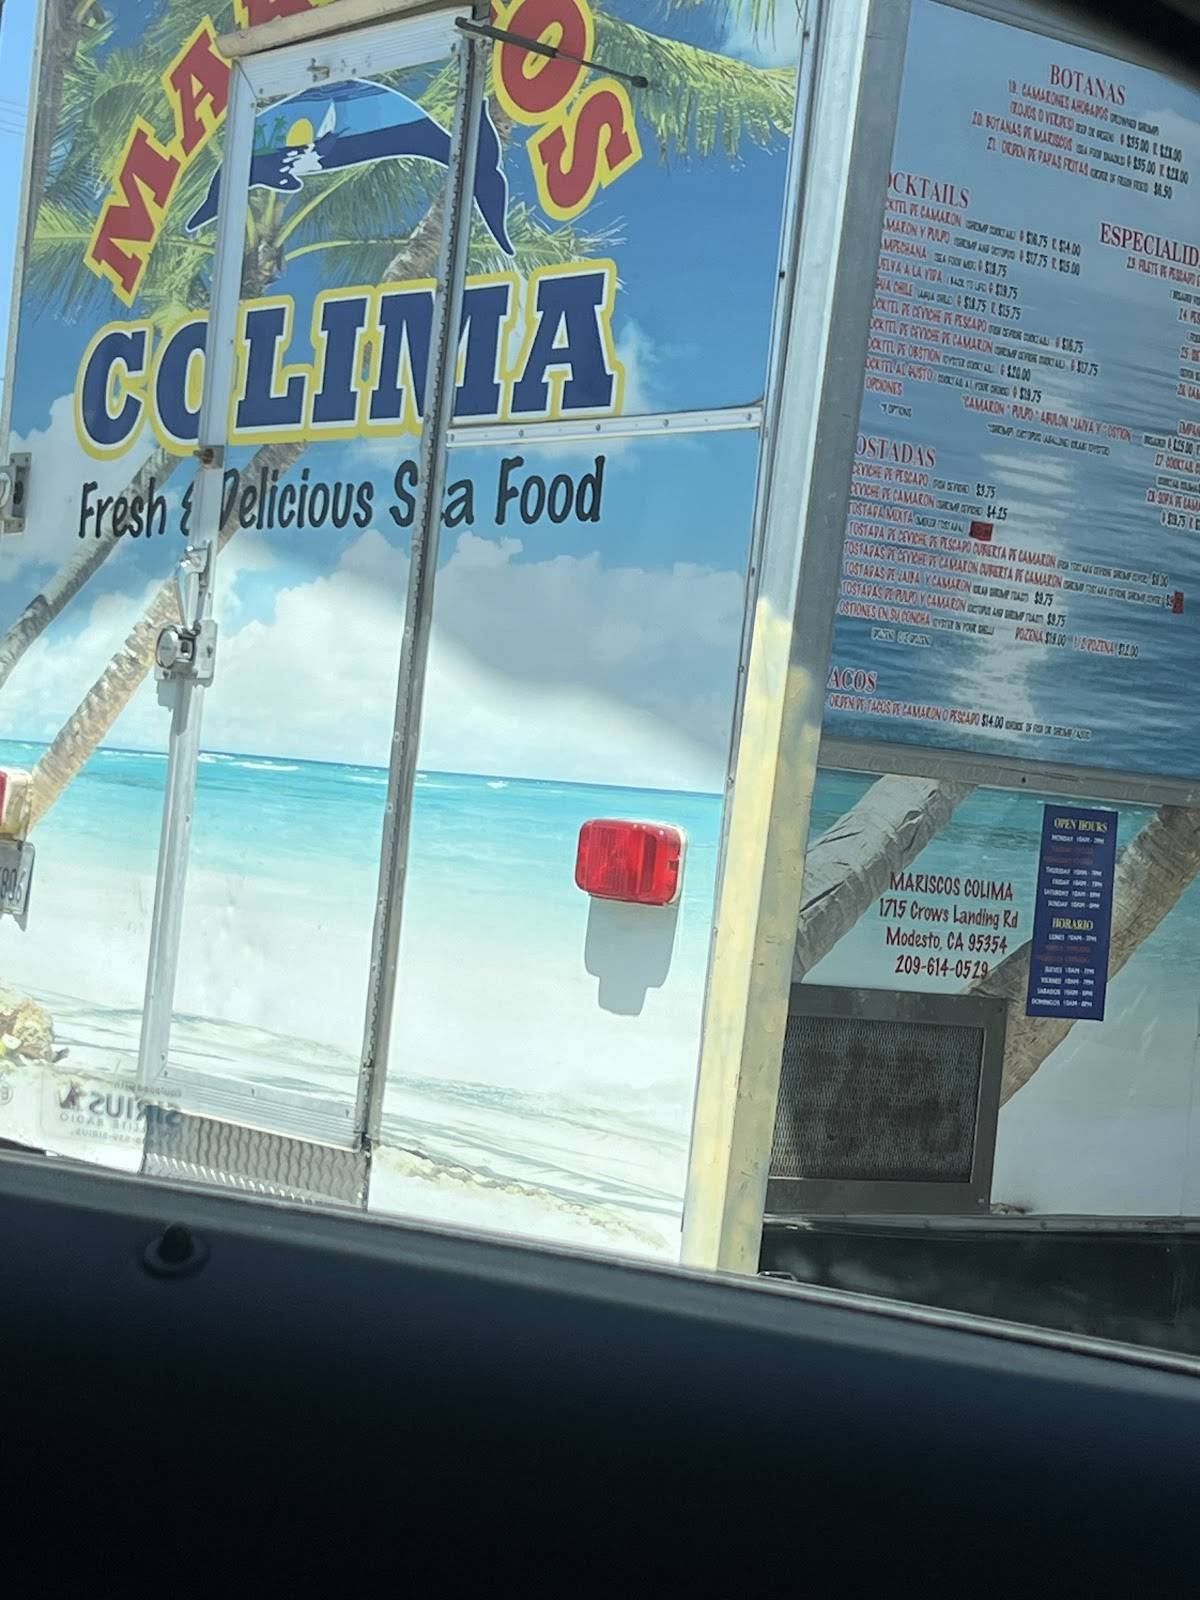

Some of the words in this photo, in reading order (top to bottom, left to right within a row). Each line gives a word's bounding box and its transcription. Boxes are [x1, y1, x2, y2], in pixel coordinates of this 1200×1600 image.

[1049, 64, 1126, 106] BOTANAS
[985, 113, 1021, 137] BOTANAS
[84, 0, 641, 305] MAOS
[879, 235, 928, 259] MPECHANA
[1100, 222, 1200, 268] ESPECIALID
[76, 262, 622, 455] COLIMA
[856, 433, 936, 468] OSTADAS
[894, 467, 929, 487] PESCADO
[79, 479, 167, 539] Fresh
[219, 467, 374, 530] Delicious
[389, 459, 475, 528] Sa
[495, 454, 606, 525] Food
[828, 667, 877, 693] ACOS
[1053, 816, 1076, 829] OPEN
[1078, 819, 1107, 832] HOURS
[890, 872, 961, 896] MARISCOS
[964, 879, 1013, 901] COLIMA
[880, 898, 907, 919] 1715
[910, 901, 949, 922] Crows
[953, 904, 999, 930] Landing
[1003, 909, 1019, 929] Rd
[1051, 916, 1093, 931] HORARIO
[886, 926, 943, 951] Modesto,
[947, 931, 963, 951] CA
[968, 933, 1008, 954] 95354
[895, 954, 989, 980] 209-614-0529
